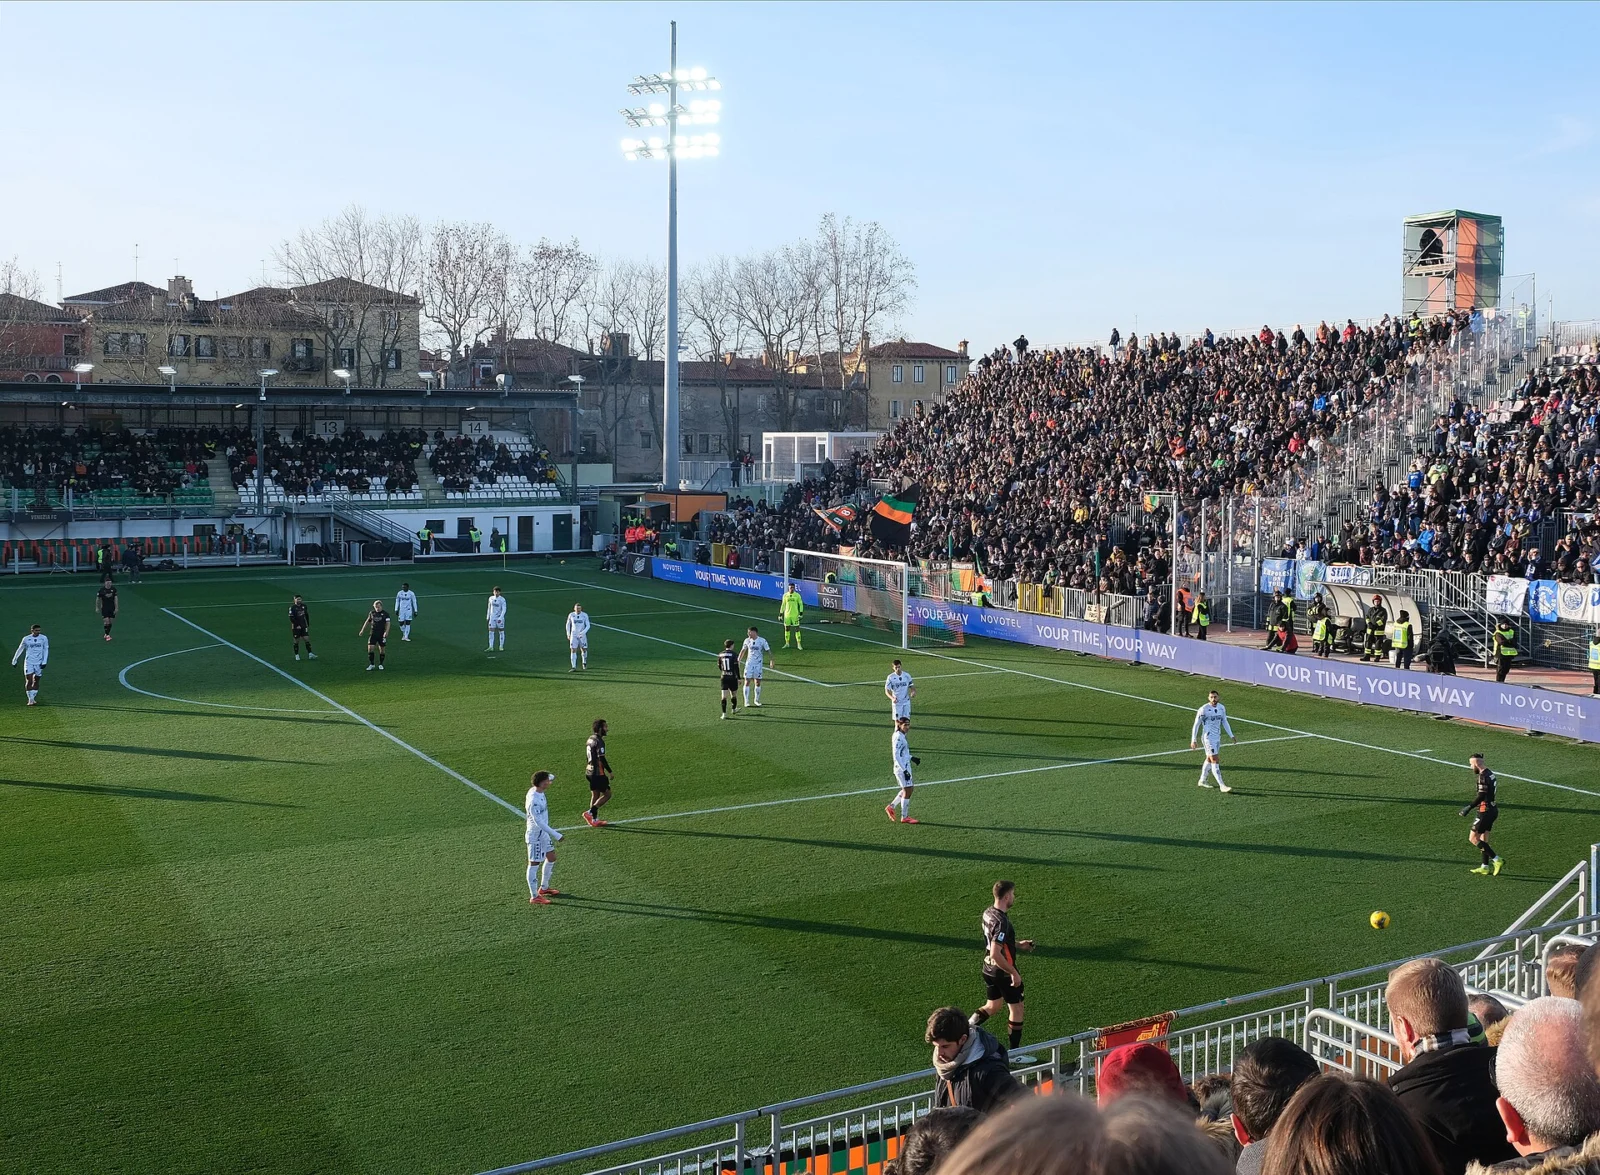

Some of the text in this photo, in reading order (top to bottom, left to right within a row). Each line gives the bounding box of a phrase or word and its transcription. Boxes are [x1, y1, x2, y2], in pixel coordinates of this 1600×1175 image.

[322, 421, 338, 433] 13
[467, 422, 482, 434] 14
[662, 563, 683, 573] NOVOTEL
[694, 569, 711, 582] YOUR
[711, 572, 728, 586] TIME,
[728, 575, 746, 587] YOUR
[746, 578, 762, 590] WAY
[775, 581, 802, 592] NOEL
[823, 585, 838, 595] NGM
[916, 606, 945, 622] YOUR
[945, 610, 969, 625] WAY
[980, 614, 1021, 629] NOVOTEL
[1036, 624, 1070, 642] YOUR
[1072, 629, 1103, 650] TIME,
[1105, 635, 1143, 653] YOUR
[1146, 641, 1178, 660] WAY
[722, 657, 731, 671] 11
[1265, 661, 1475, 708] YOUR TIME, YOUR WAY
[1500, 692, 1587, 719] NOVOTEL
[1528, 713, 1556, 722] VENEZIA
